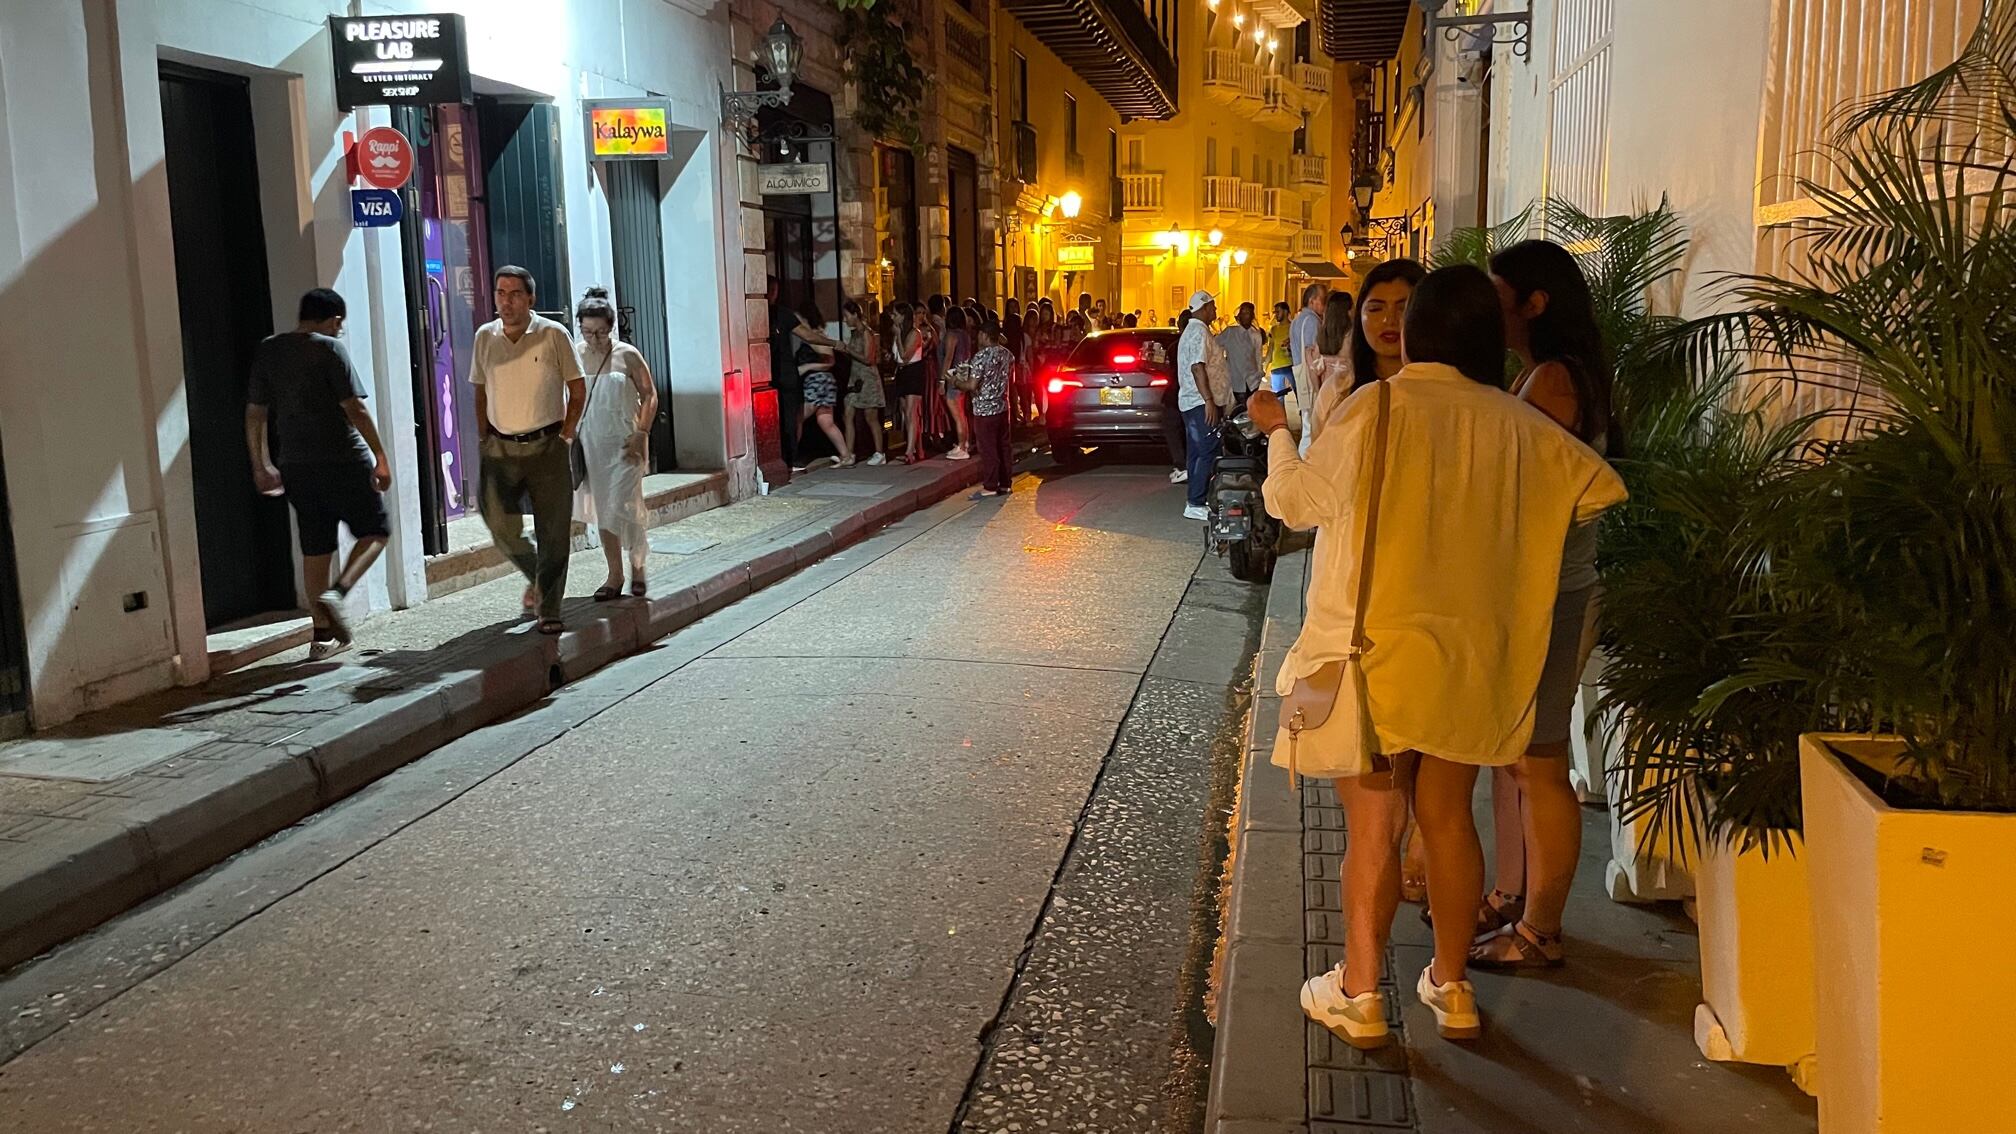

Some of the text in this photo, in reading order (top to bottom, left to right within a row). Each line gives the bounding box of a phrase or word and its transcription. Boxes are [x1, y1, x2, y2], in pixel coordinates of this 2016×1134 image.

[347, 20, 440, 41] PLEASURE
[377, 41, 414, 60] LAB
[394, 73, 433, 81] INTIMACY
[382, 86, 420, 97] SEX SHOP
[595, 118, 665, 145] Kalaywa
[368, 139, 400, 156] Rappi
[359, 201, 393, 216] VISA
